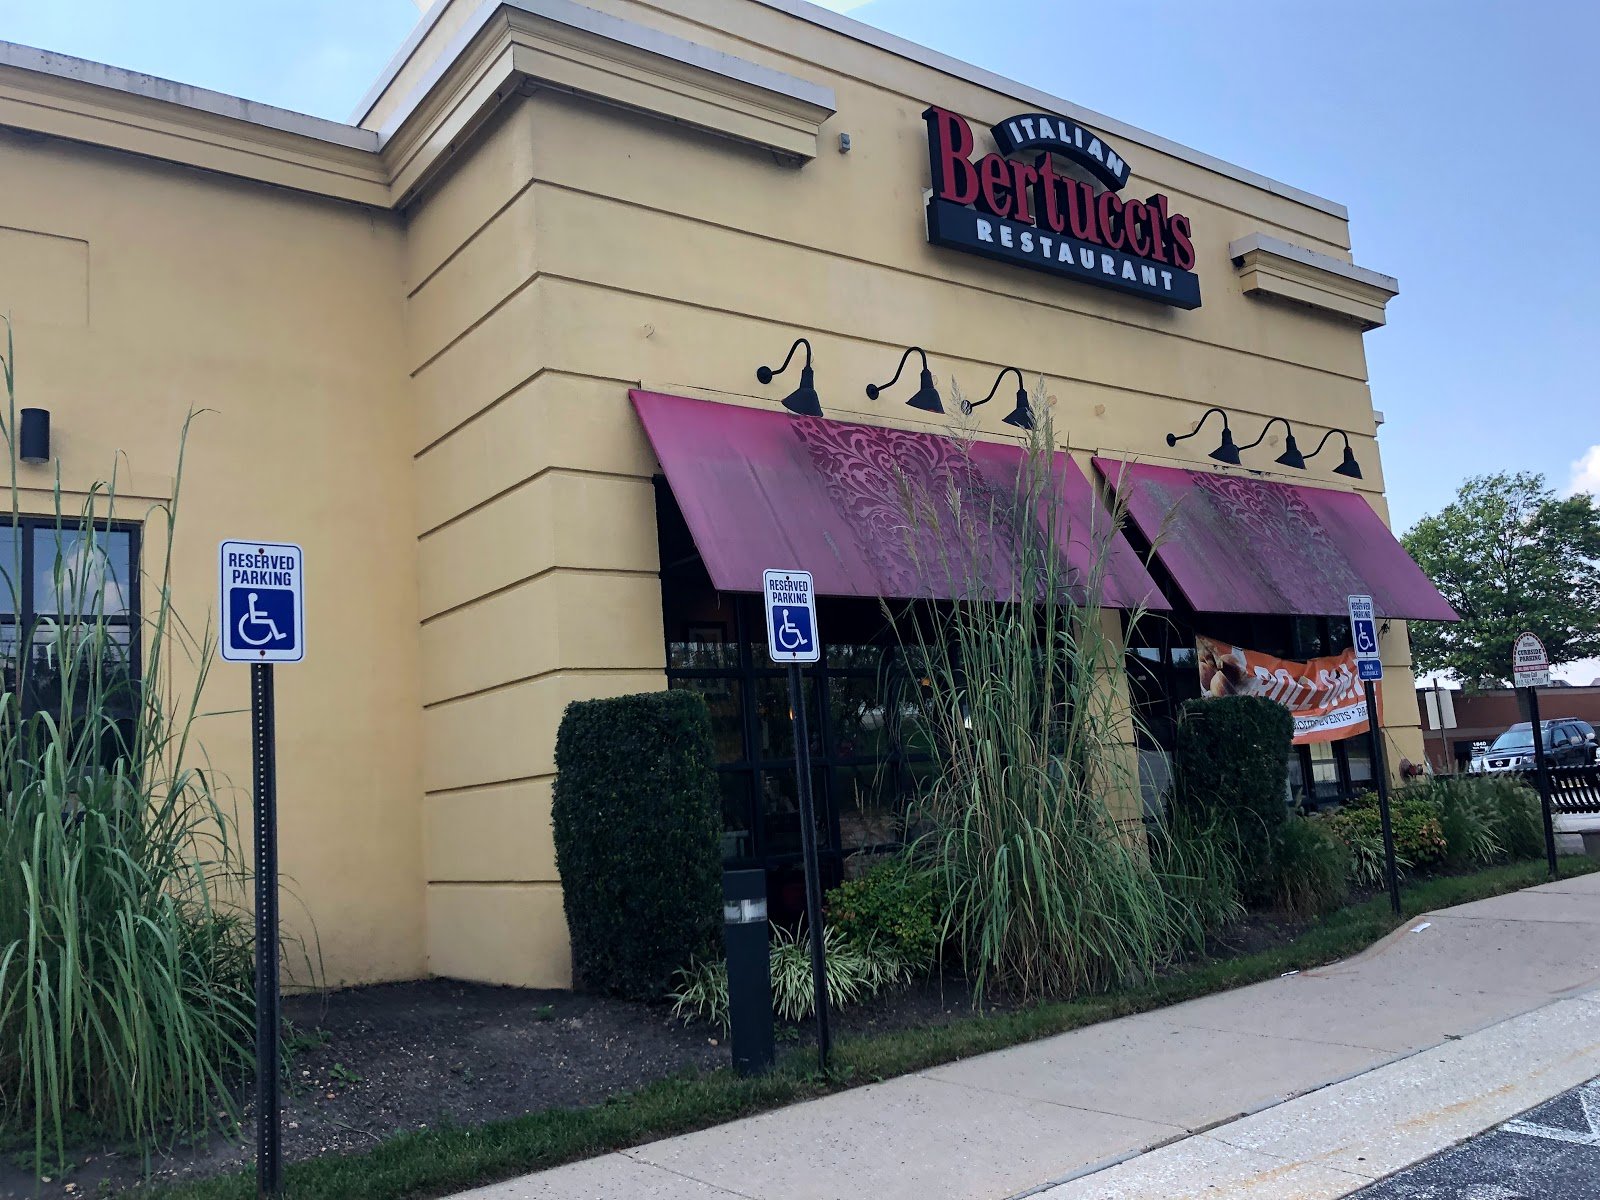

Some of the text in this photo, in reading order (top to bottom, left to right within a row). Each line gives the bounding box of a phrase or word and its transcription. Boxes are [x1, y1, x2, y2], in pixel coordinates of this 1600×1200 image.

[1008, 117, 1124, 178] ITALIAN
[931, 105, 1196, 271] Bertucci's
[976, 218, 1172, 291] RESTAURANT
[228, 552, 295, 571] RESERVED
[232, 569, 292, 586] PARKING
[769, 579, 809, 592] RESERVED
[772, 591, 808, 604] PARKING
